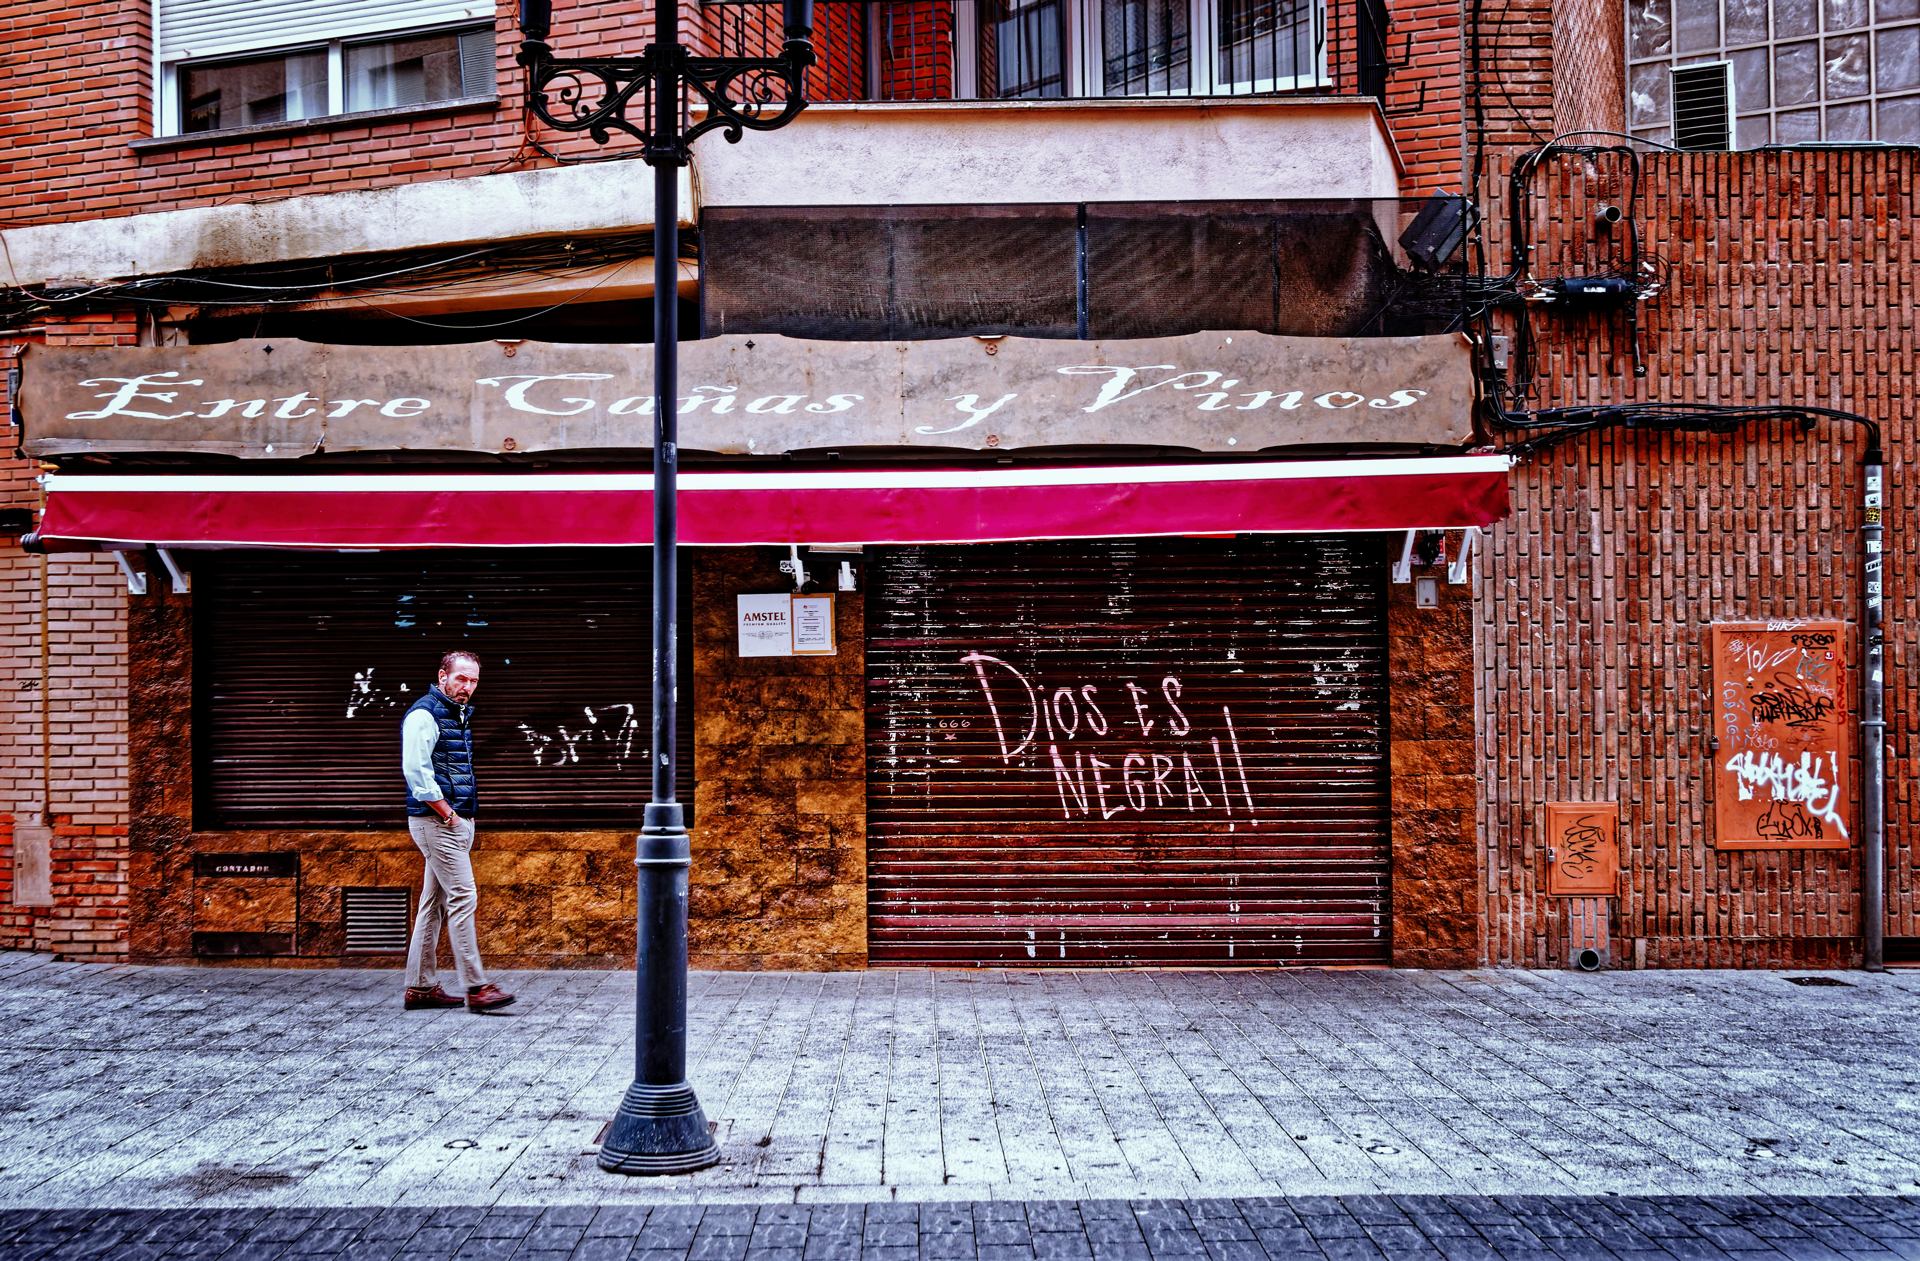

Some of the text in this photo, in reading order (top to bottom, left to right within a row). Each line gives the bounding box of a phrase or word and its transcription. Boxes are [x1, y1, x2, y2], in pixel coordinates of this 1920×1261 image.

[65, 364, 1428, 435] Entre Cañas y Vinos
[743, 611, 786, 621] AMSTEL
[938, 718, 971, 729] 666
[1126, 676, 1191, 737] ES
